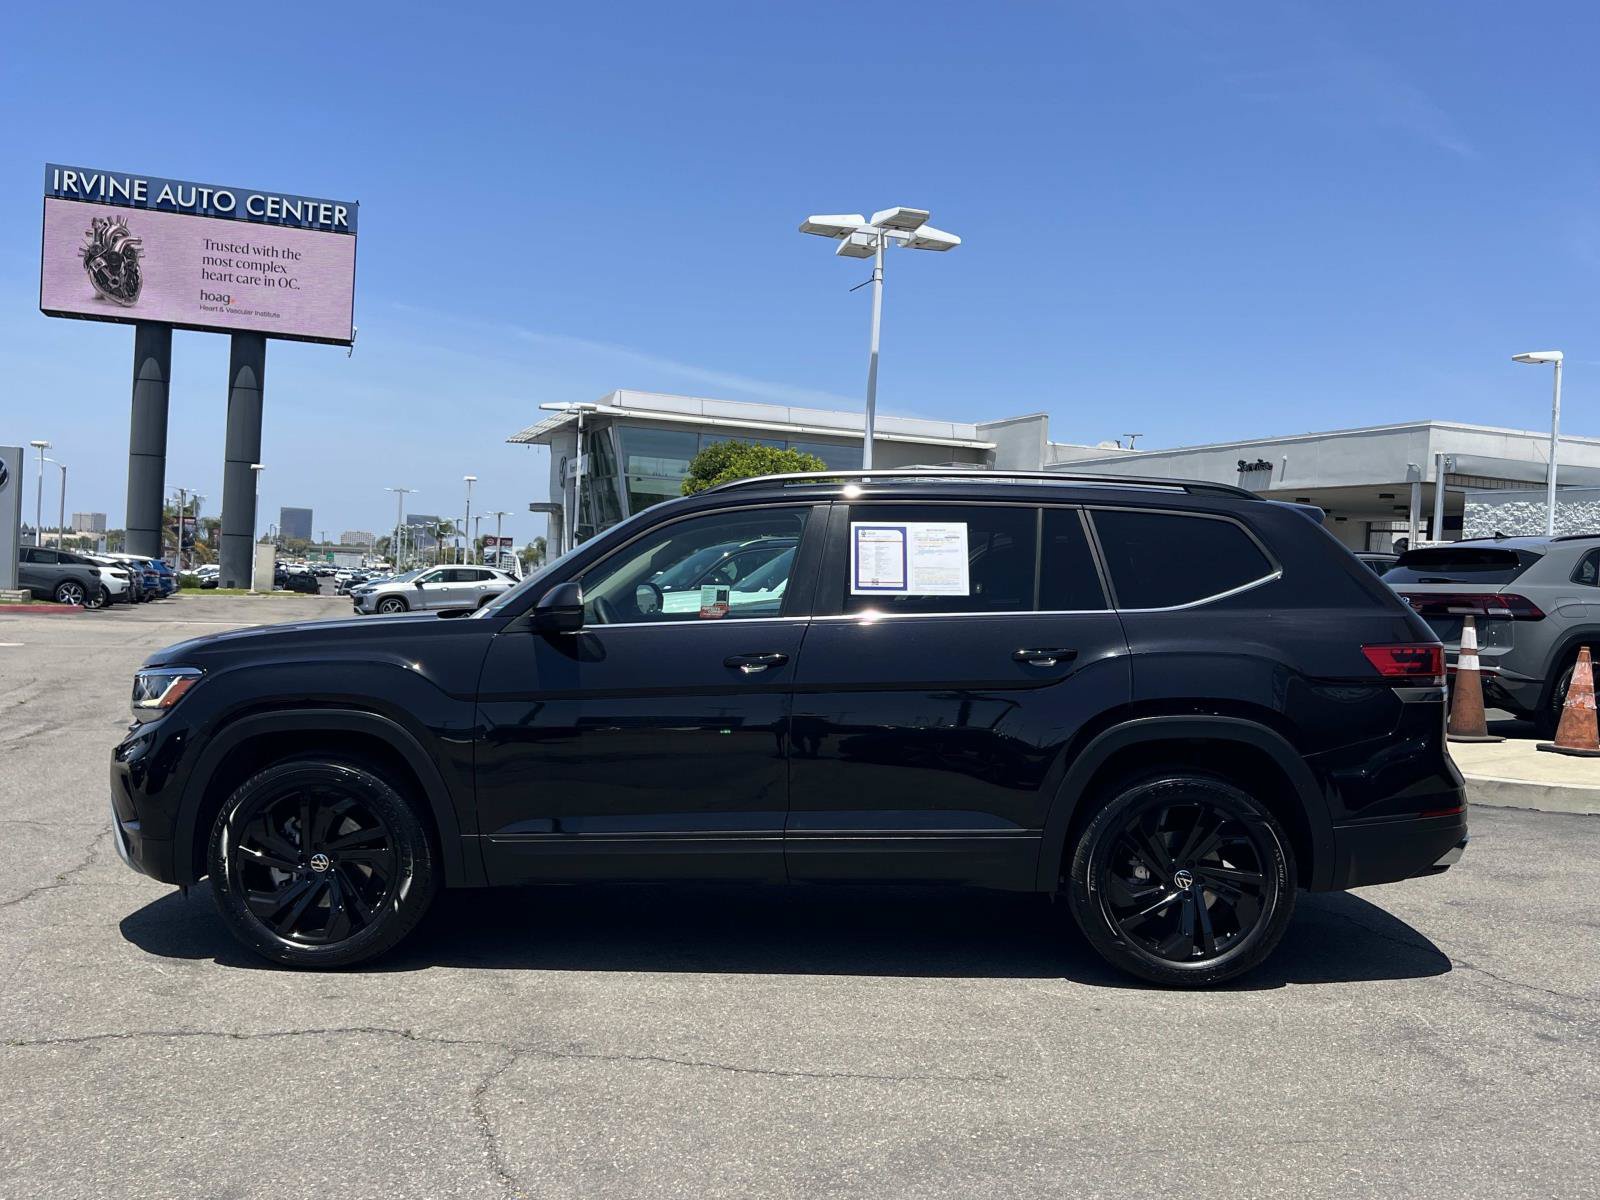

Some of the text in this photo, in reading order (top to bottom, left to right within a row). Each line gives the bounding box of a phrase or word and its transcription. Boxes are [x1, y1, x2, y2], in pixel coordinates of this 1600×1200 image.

[53, 169, 348, 226] IRVINE AUTO CENTER
[203, 238, 301, 260] Trusted with the
[202, 256, 287, 274] most complex
[201, 268, 300, 290] heart care in OC.
[200, 304, 218, 312] Heart
[225, 307, 253, 315] Vascular
[254, 310, 281, 318] Institute
